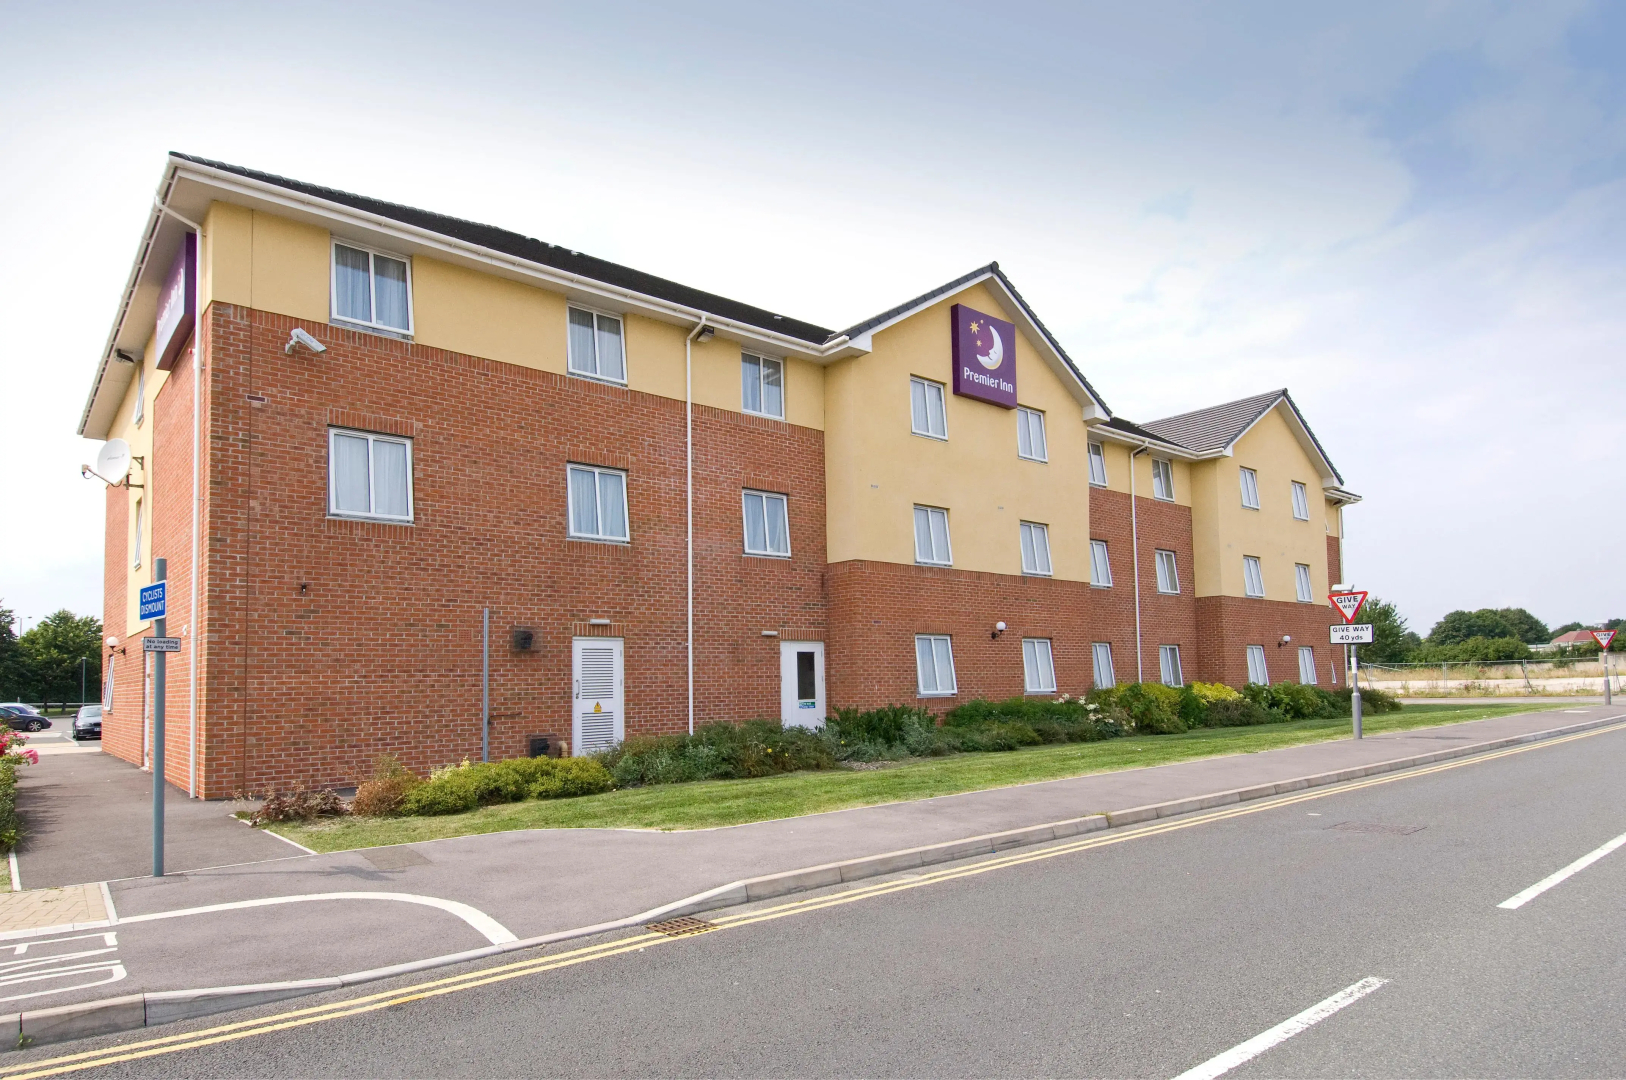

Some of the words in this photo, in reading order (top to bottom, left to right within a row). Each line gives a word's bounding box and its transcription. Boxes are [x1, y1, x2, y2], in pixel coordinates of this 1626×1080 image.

[963, 366, 999, 389] Premier
[1000, 378, 1014, 394] Inn
[142, 587, 163, 602] CYCLISTS
[1336, 595, 1359, 604] GIVE
[140, 601, 165, 615] DISMOUNT
